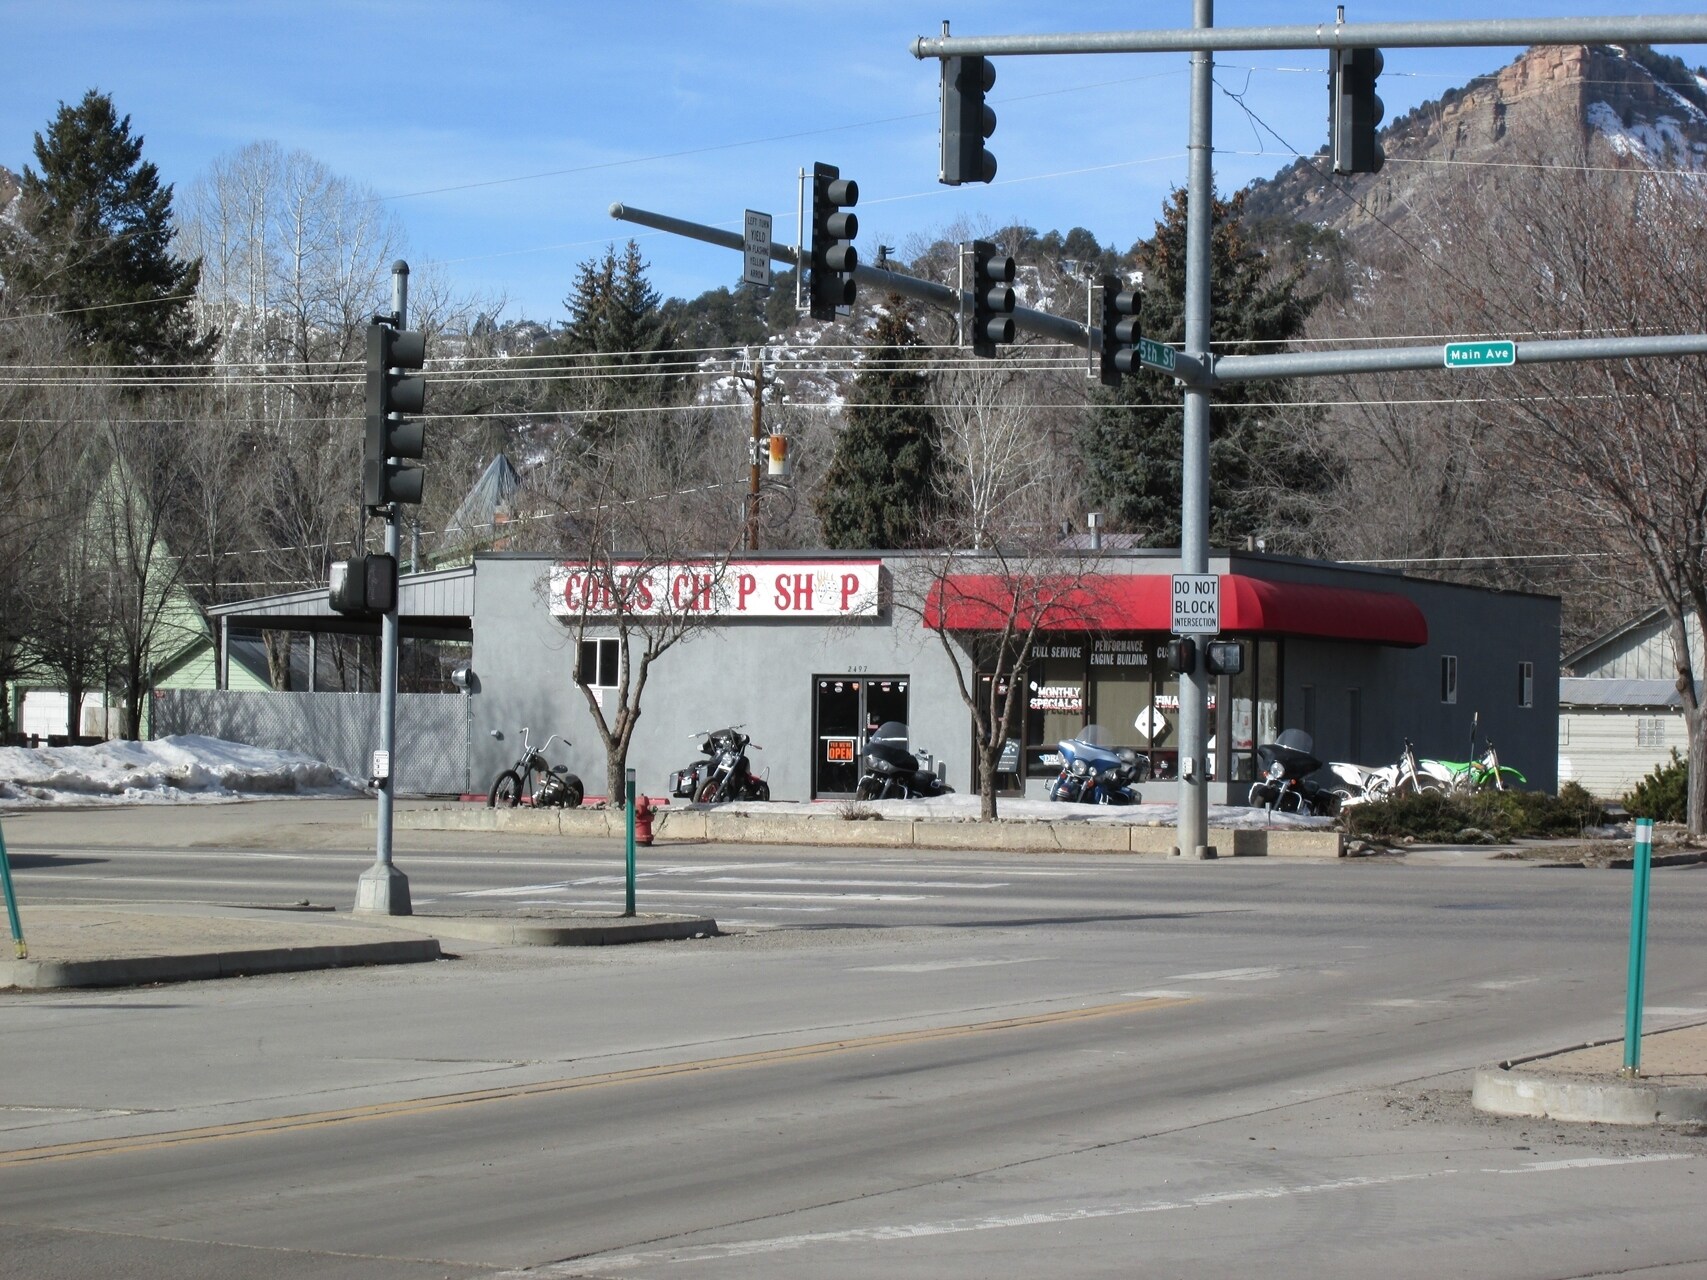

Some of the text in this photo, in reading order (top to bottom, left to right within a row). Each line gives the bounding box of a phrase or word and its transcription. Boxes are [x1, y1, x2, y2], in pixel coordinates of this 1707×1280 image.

[747, 216, 770, 229] LEFT TURN
[751, 229, 766, 243] YIELD
[750, 256, 765, 267] YELLOW
[750, 269, 764, 279] ARROW
[1163, 347, 1174, 368] St
[1451, 348, 1509, 360] Main Ave
[1174, 581, 1217, 595] DO NOT
[1175, 600, 1215, 614] BLOCK
[1174, 617, 1217, 627] INTERSECTION
[1031, 646, 1082, 658] FULL SERVICE
[1094, 640, 1144, 652] PERFORMANCE
[1090, 653, 1148, 665] ENGINE BUILDING
[847, 665, 868, 673] 2497
[1037, 686, 1081, 698] MONTHLY
[1029, 698, 1083, 710] SPECIALS!
[829, 747, 852, 760] OPEN
